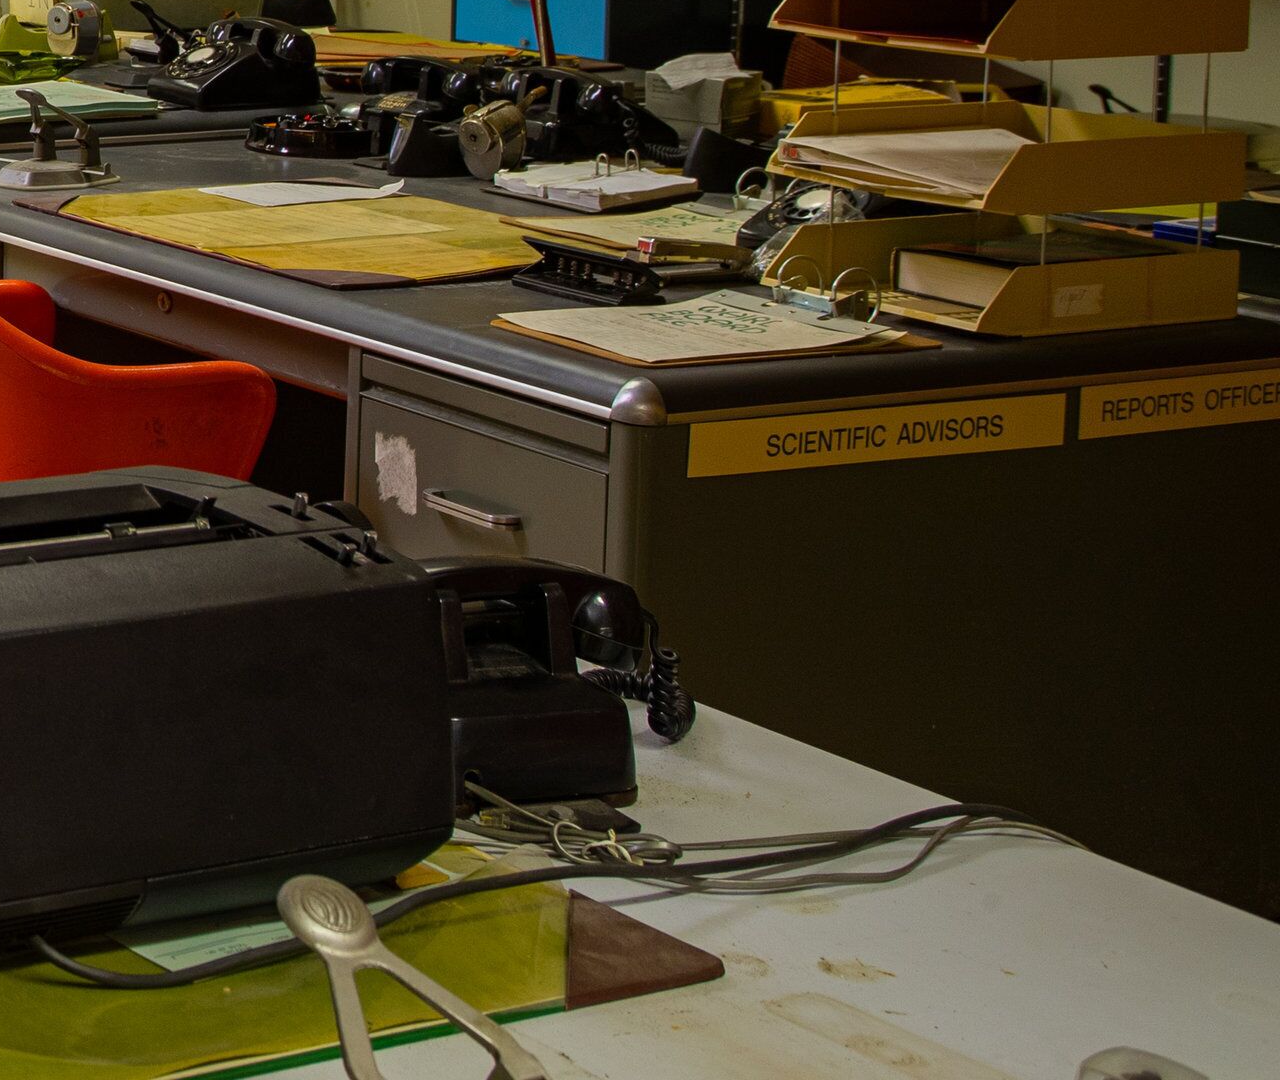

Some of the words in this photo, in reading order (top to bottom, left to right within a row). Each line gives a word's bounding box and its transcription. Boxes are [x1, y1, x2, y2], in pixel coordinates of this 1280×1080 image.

[1102, 391, 1195, 422] REPORTS
[766, 425, 887, 458] SCIENTIFIC
[897, 414, 1005, 446] ADVISORS
